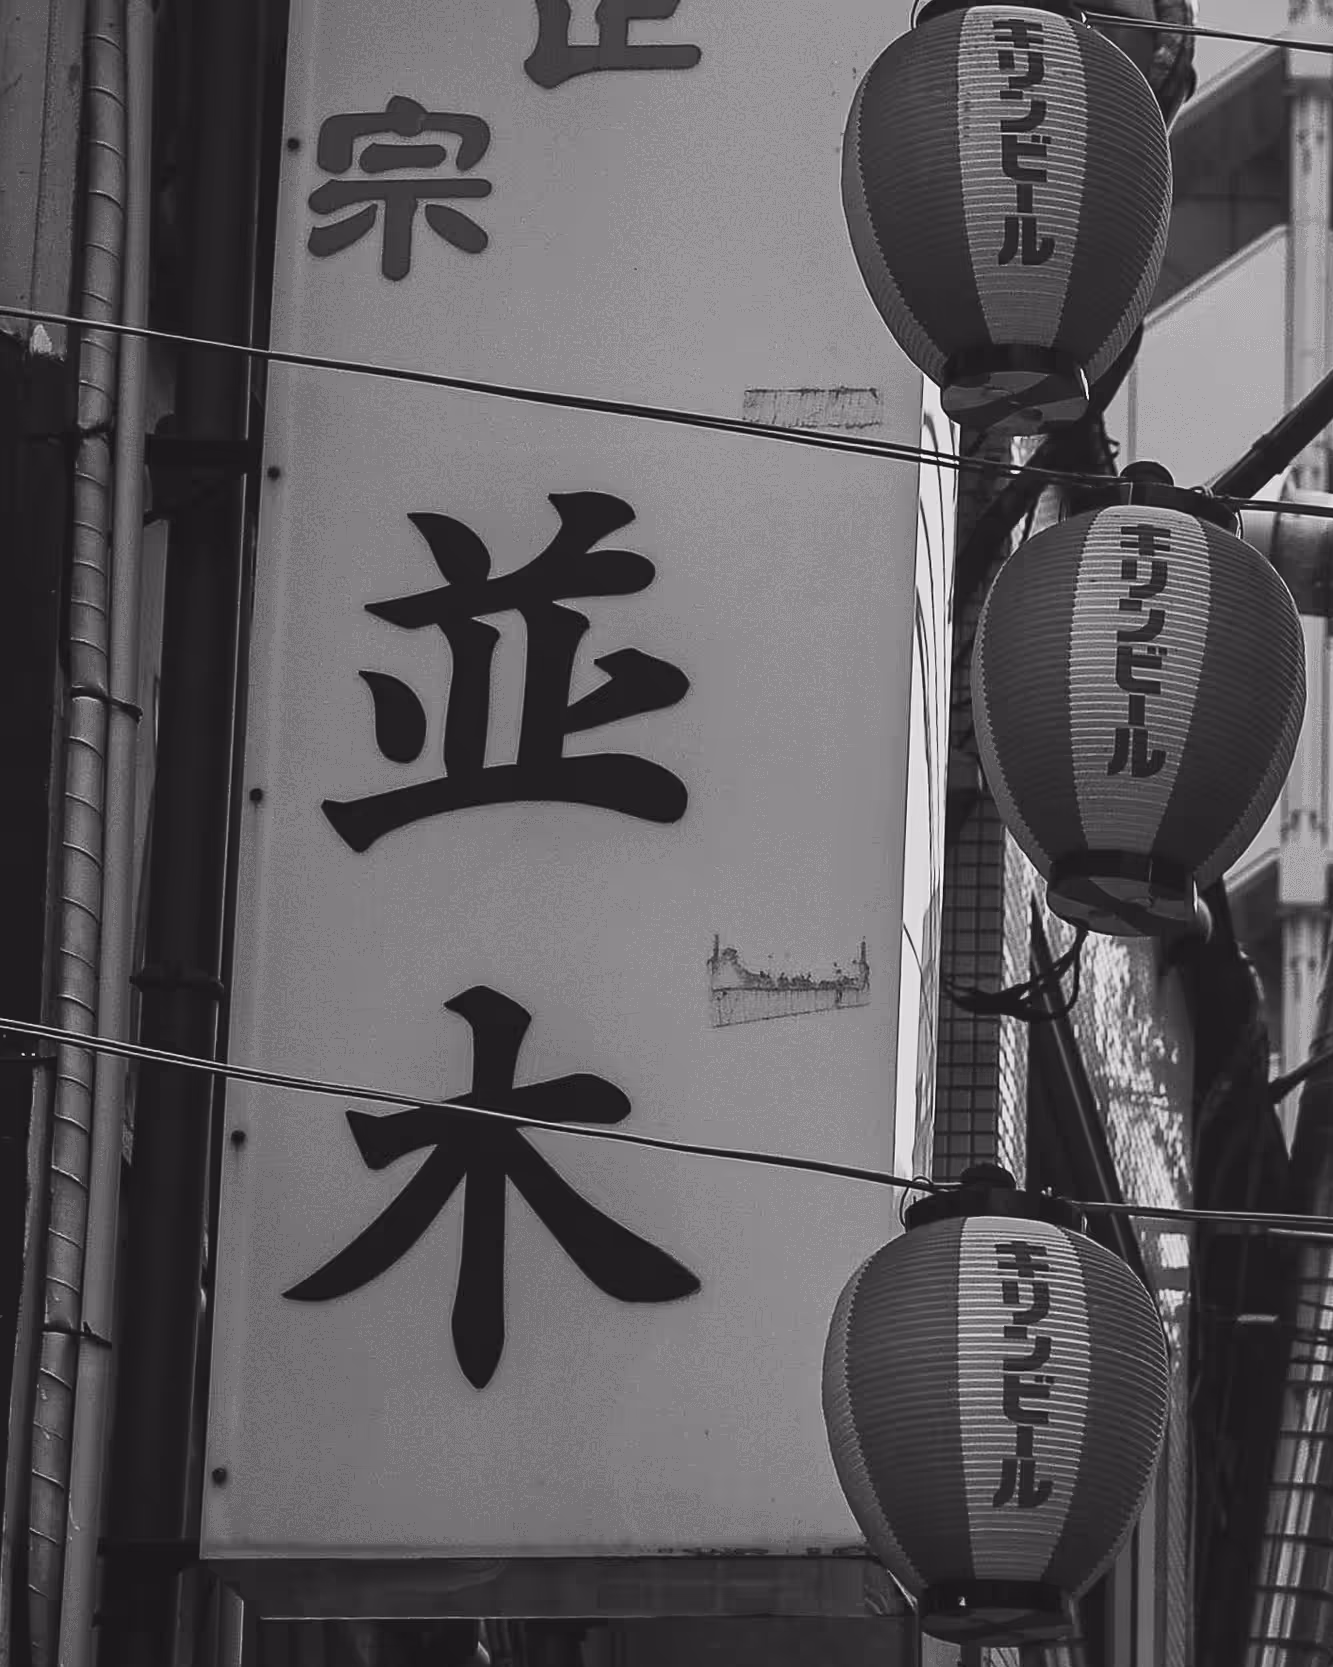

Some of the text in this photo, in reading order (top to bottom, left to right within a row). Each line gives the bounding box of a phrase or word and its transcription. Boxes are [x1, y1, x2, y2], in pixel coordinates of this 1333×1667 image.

[993, 18, 1055, 266] キリンビール
[1106, 523, 1171, 778] キリンビール
[283, 490, 702, 1389] 並木
[992, 1241, 1055, 1508] キリンビール
